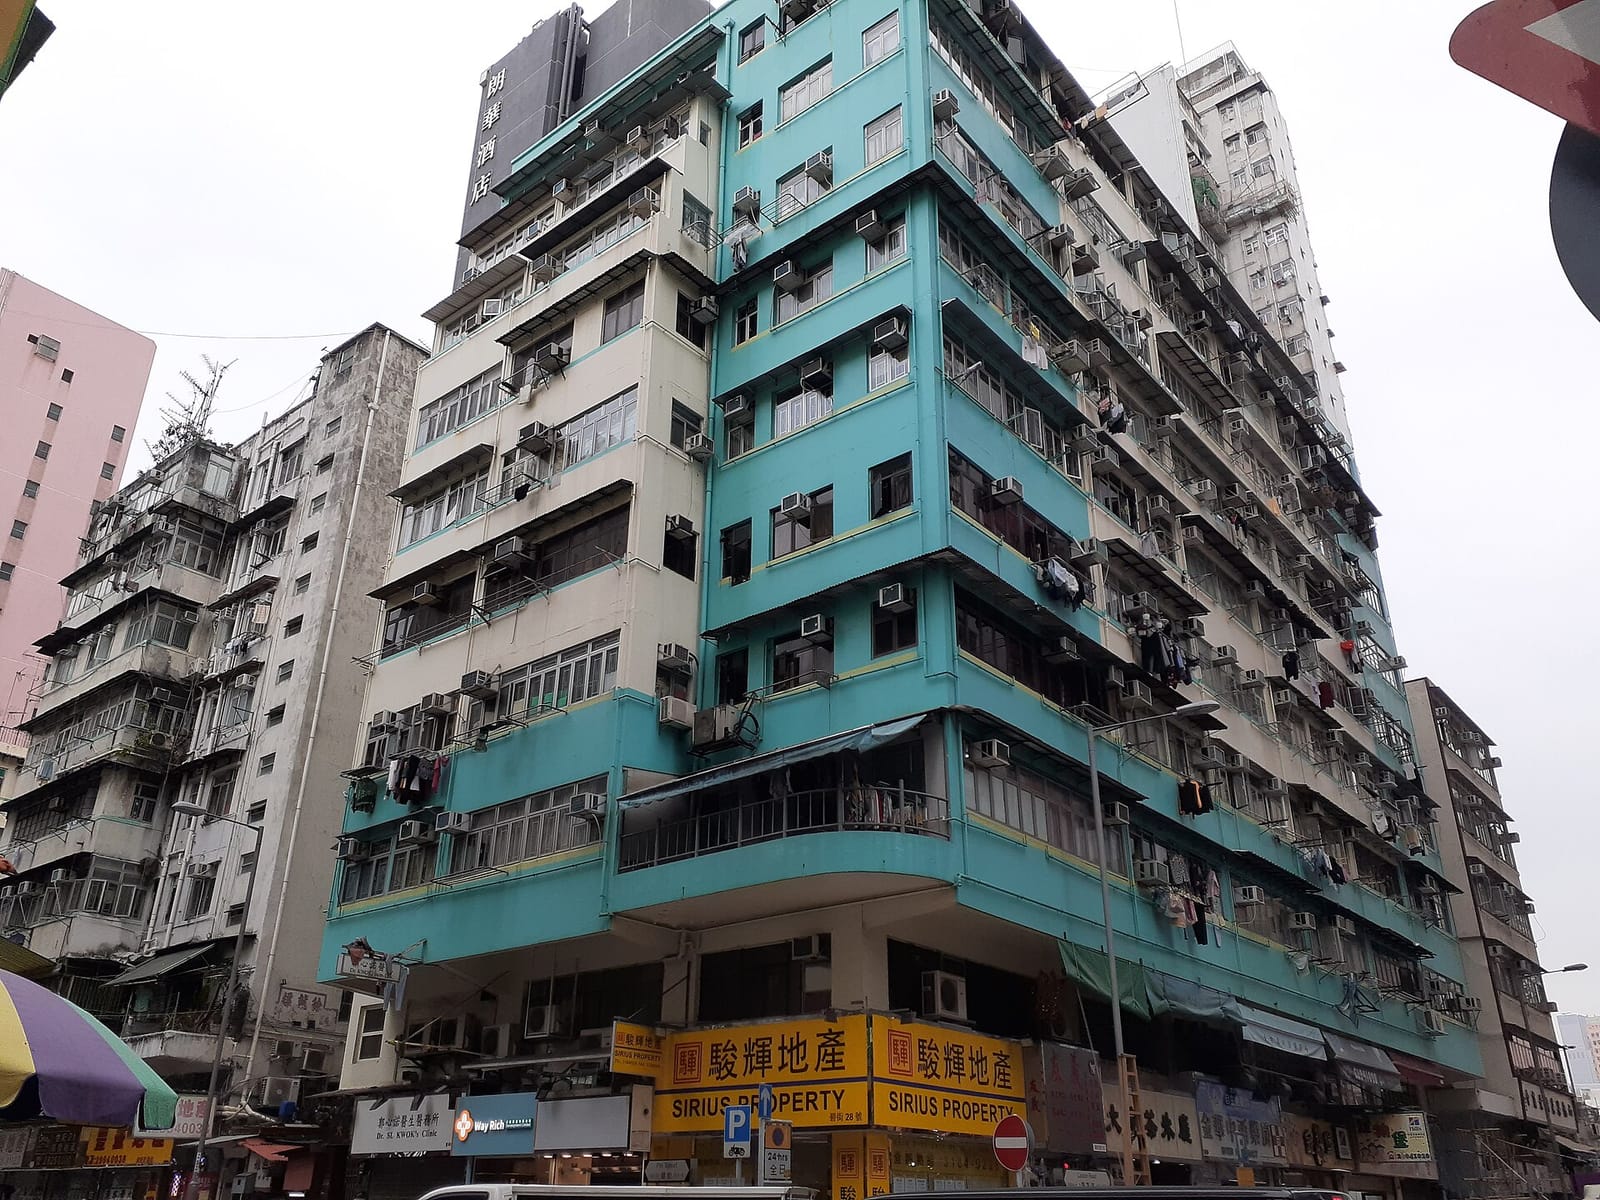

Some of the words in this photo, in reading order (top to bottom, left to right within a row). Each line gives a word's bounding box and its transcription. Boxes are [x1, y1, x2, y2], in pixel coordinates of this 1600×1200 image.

[708, 1028, 846, 1081] 駿輝地產
[917, 1038, 1014, 1090] 駿輝地產
[672, 1096, 730, 1118] SIRIUS
[889, 1090, 938, 1117] SIRIUS
[943, 1098, 1014, 1123] PROPERTY
[422, 1129, 438, 1138] Clinic
[474, 1121, 489, 1133] Way
[489, 1119, 505, 1131] Rich
[729, 1109, 746, 1139] P
